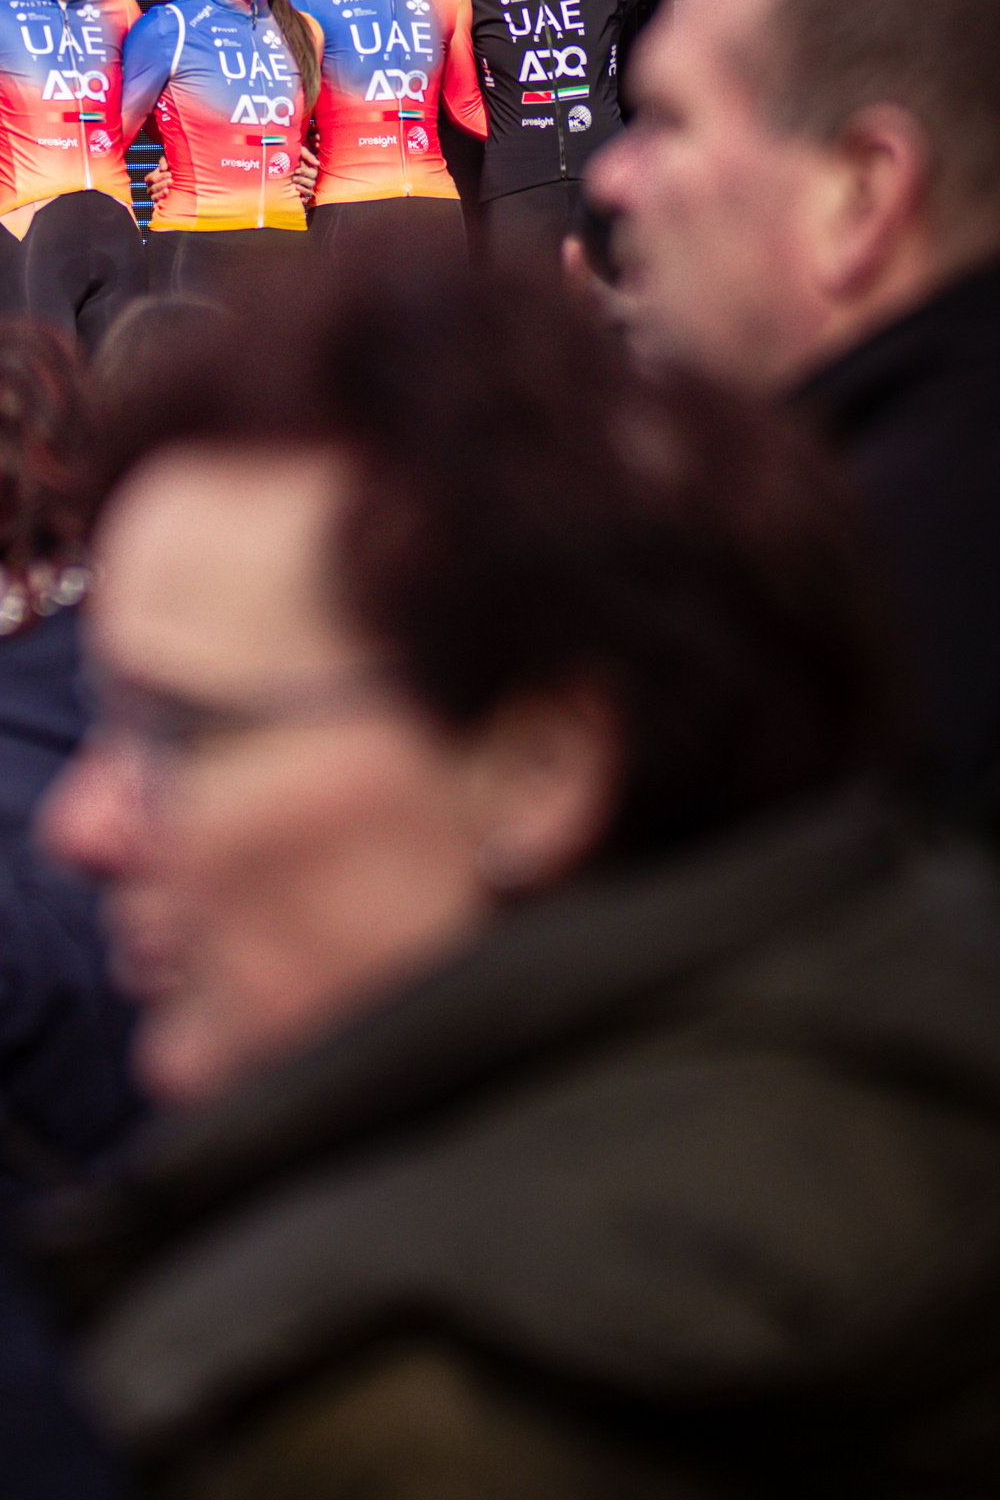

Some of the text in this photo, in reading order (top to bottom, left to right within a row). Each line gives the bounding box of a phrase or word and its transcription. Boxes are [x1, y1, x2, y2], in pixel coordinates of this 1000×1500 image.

[21, 25, 107, 55] UAE
[350, 21, 434, 54] UAE
[219, 51, 292, 81] UAE
[359, 54, 434, 63] TEAM
[519, 45, 588, 82] ADQ
[42, 69, 110, 103] ADQ
[365, 69, 429, 102] ADQ
[230, 94, 296, 127] ADQ
[522, 116, 555, 129] presight
[38, 136, 79, 150] presight
[358, 135, 398, 148] presight
[221, 158, 261, 171] presight
